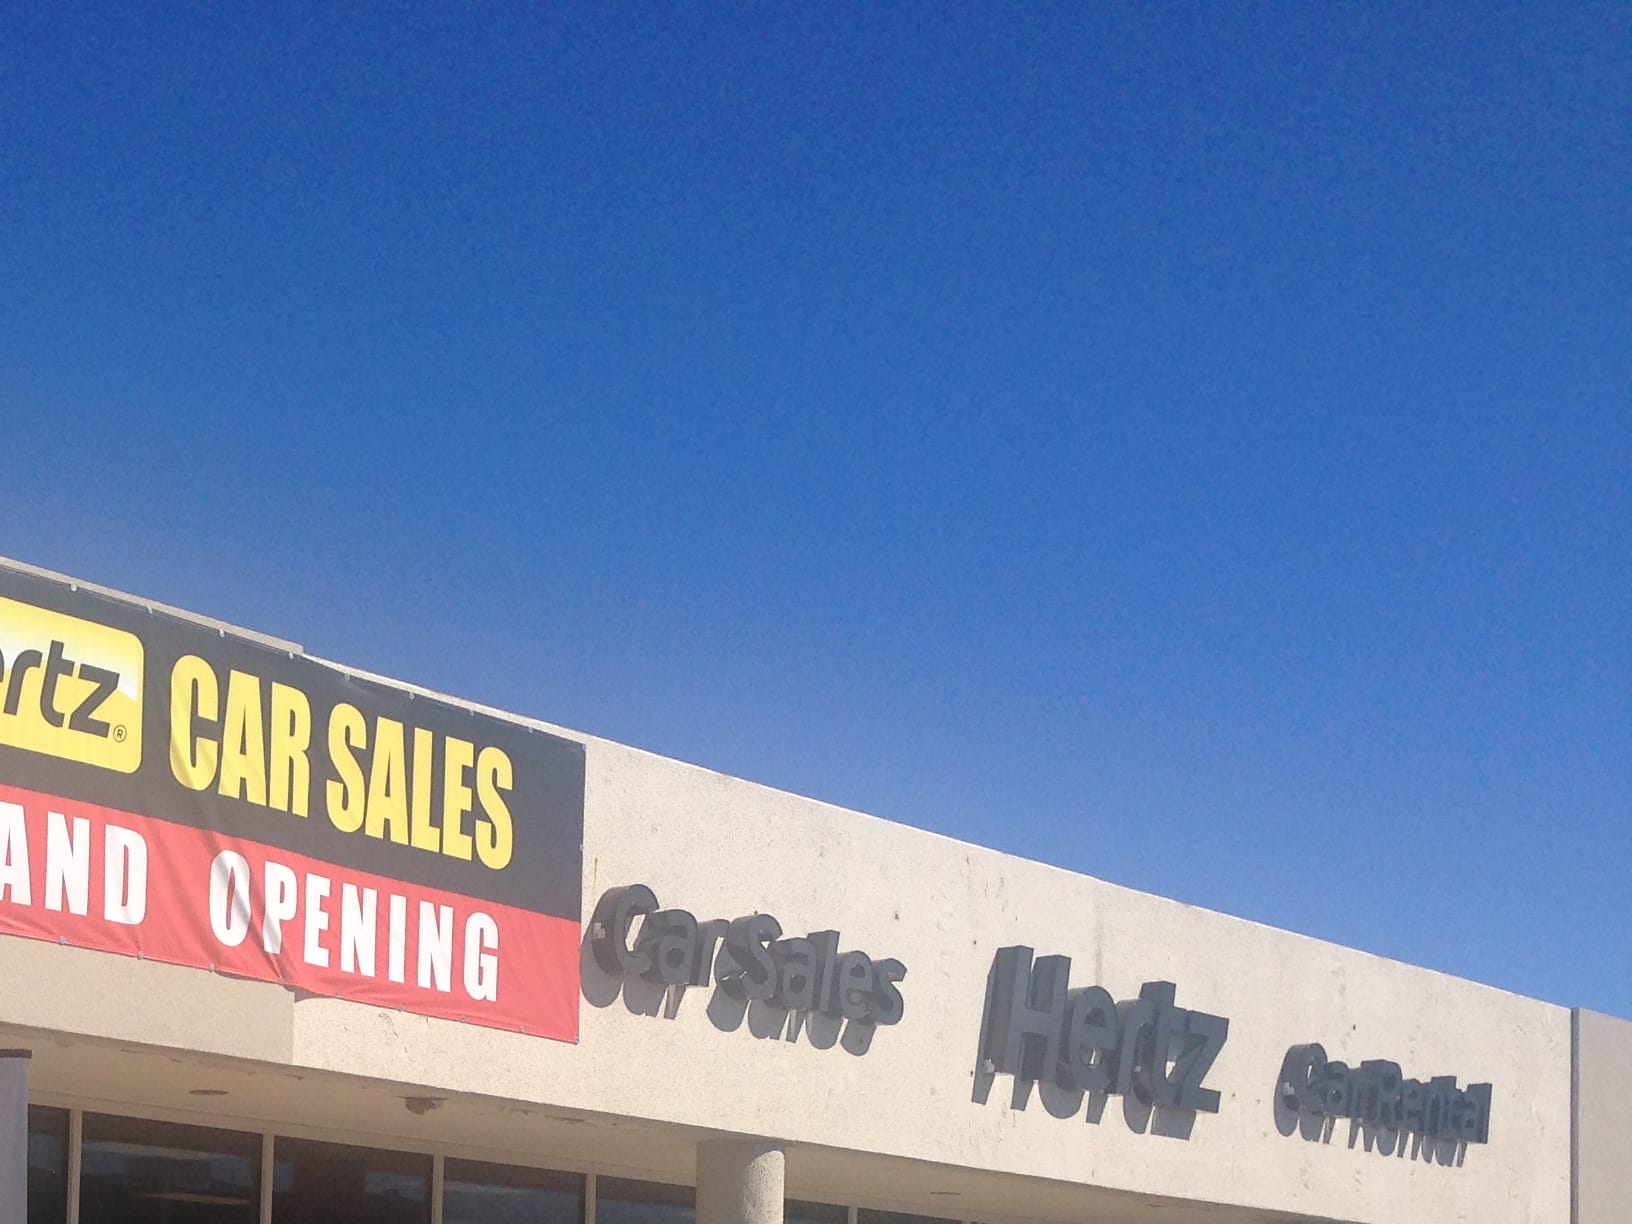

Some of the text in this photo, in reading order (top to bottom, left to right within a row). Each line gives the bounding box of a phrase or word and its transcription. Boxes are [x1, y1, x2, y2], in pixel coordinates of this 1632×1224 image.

[169, 654, 312, 818] CAR
[325, 701, 513, 871] SALES
[208, 849, 500, 1002] OPENING
[976, 945, 1230, 1116] Hertz
